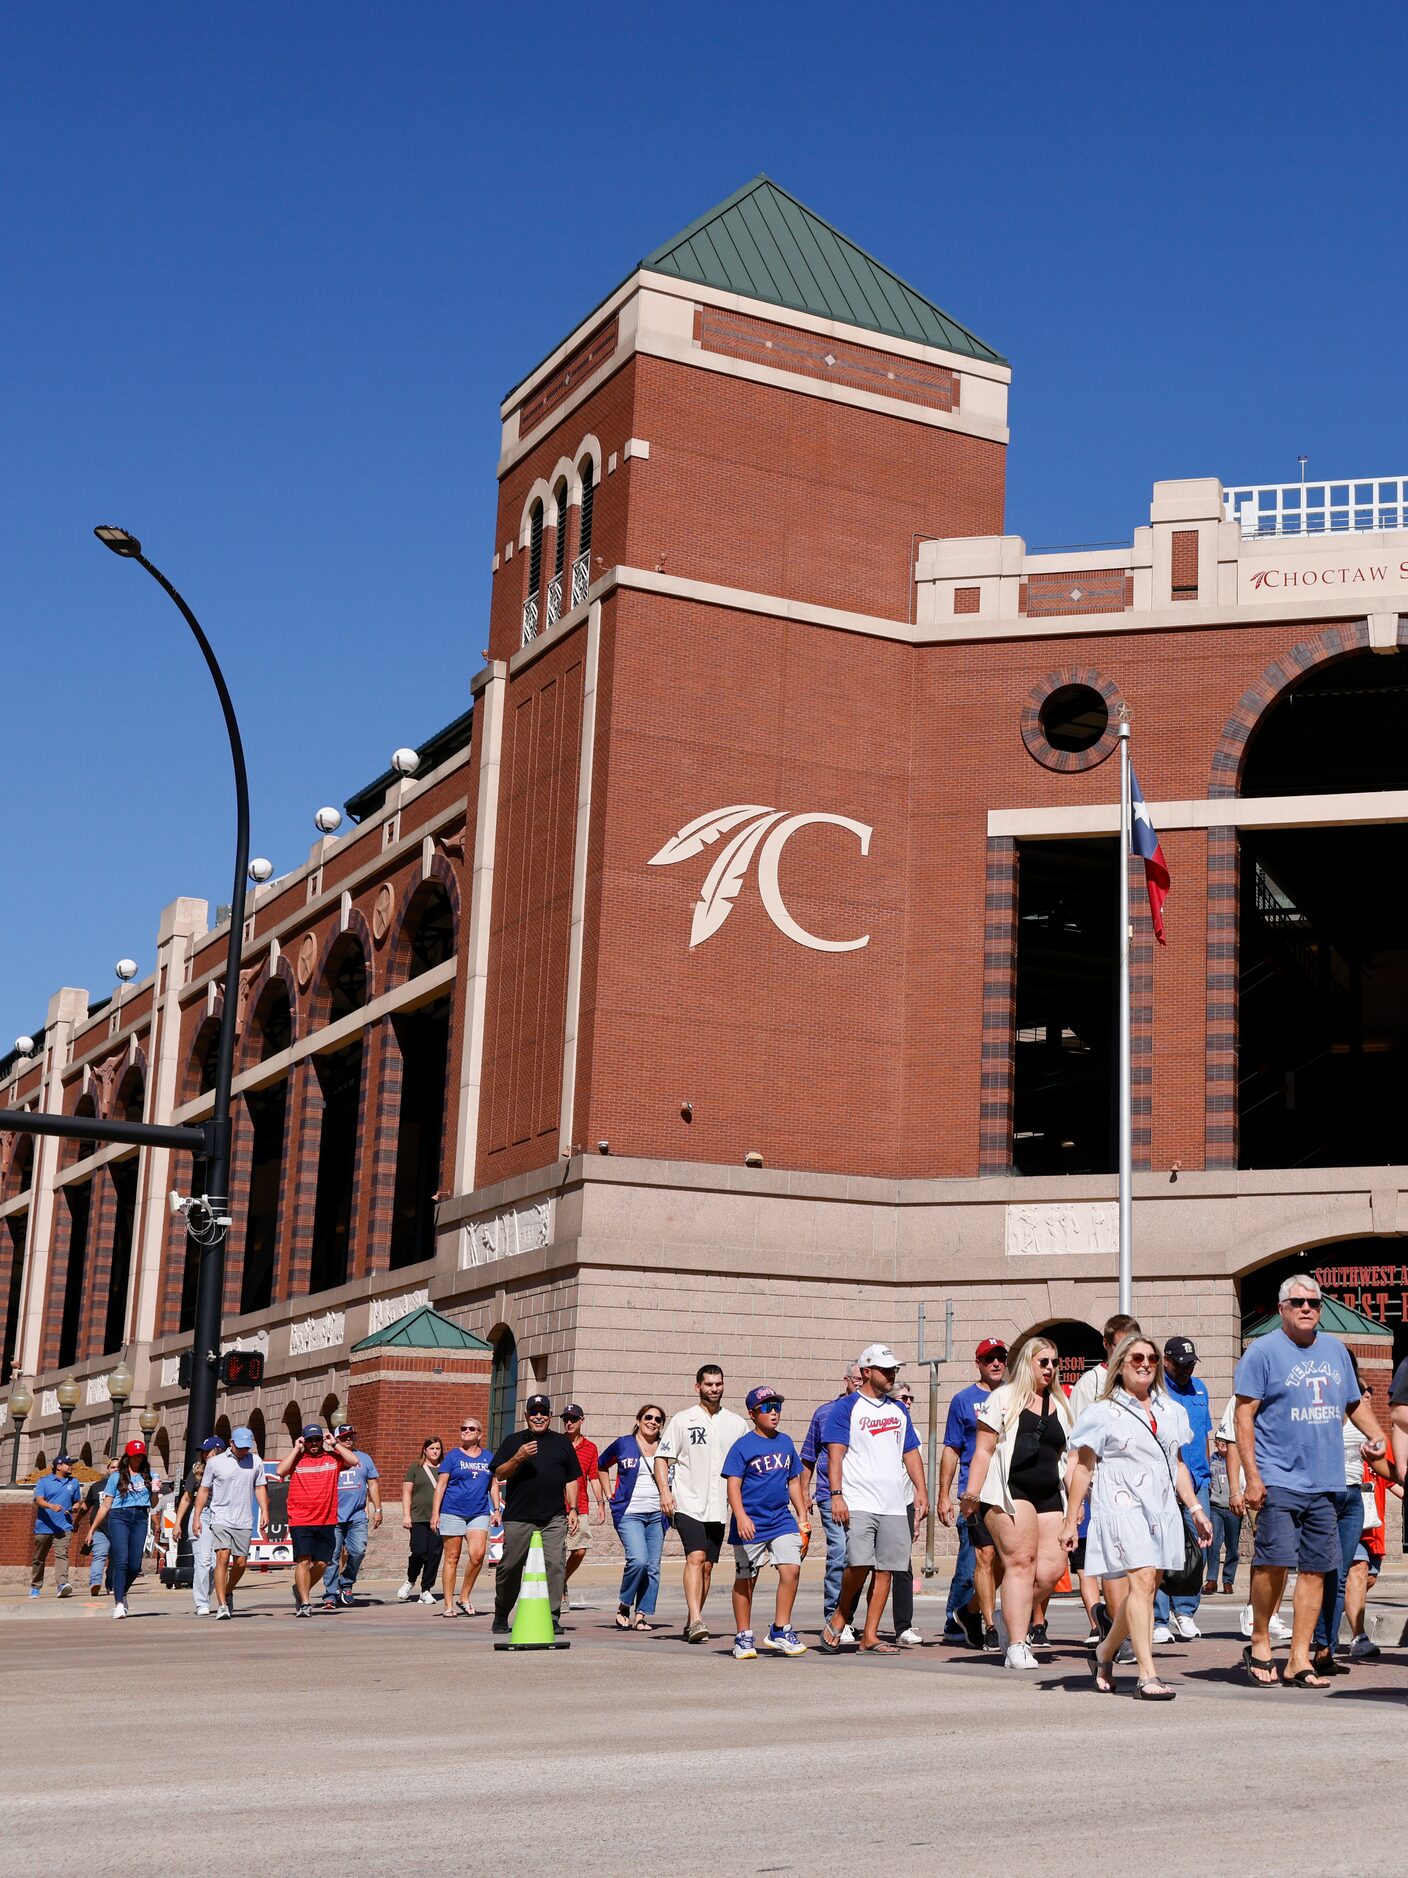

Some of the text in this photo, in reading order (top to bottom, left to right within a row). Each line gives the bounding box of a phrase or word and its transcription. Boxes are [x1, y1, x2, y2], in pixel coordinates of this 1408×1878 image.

[1263, 565, 1389, 588] CHOCTAW
[1315, 1265, 1397, 1288] SOUTHWEST
[1284, 1359, 1342, 1388] TEXAS
[1305, 1376, 1328, 1406] T
[859, 1416, 901, 1431] Rangers
[1290, 1405, 1341, 1422] RANGERS
[460, 1460, 489, 1472] RANGERS
[751, 1453, 791, 1474] TEXA
[339, 1470, 356, 1485] T
